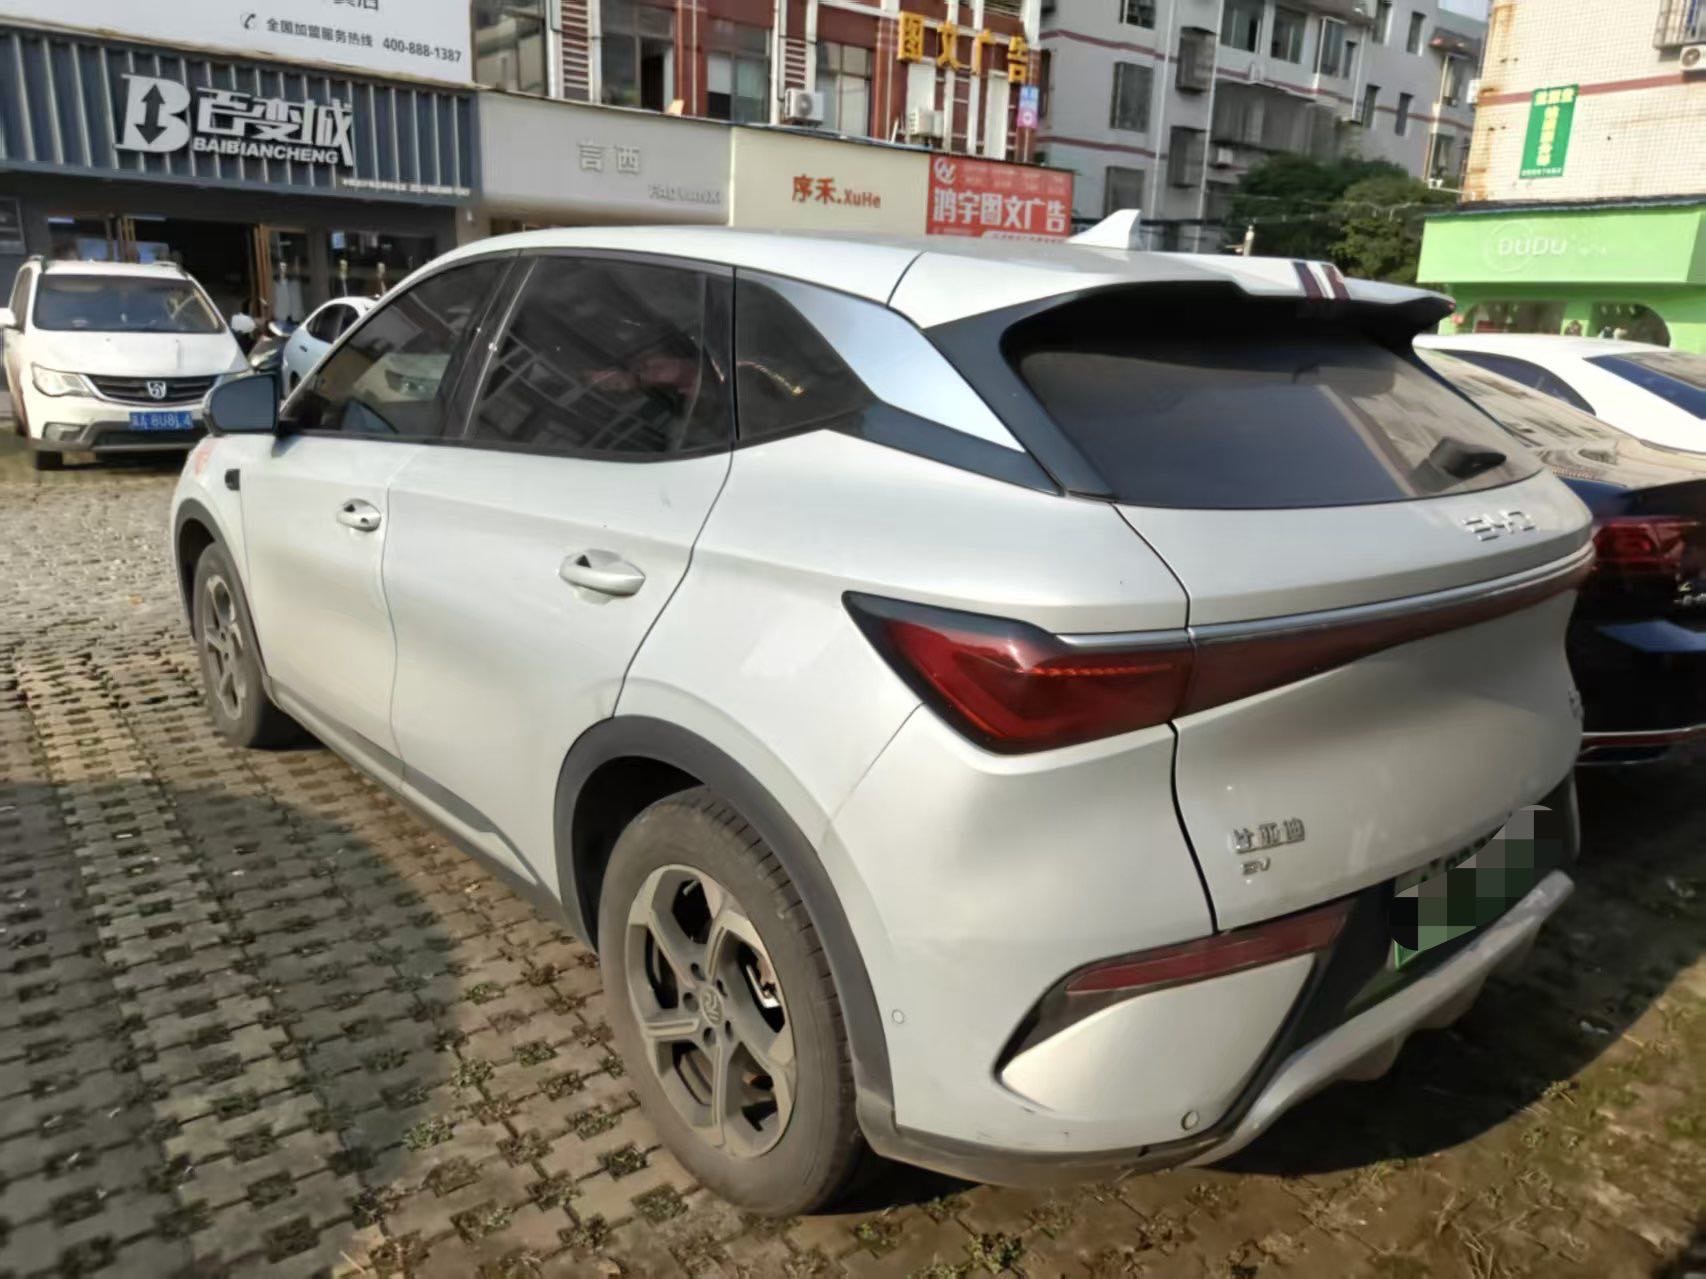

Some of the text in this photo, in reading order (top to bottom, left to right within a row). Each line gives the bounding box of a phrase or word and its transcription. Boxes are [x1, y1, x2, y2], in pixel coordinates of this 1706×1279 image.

[266, 18, 462, 62] 全国加盟服务热线 400-888-1387
[195, 86, 354, 167] 百变城
[192, 138, 340, 166] BAIBIANCHENG
[932, 186, 1067, 233] 鸿宇图文广告
